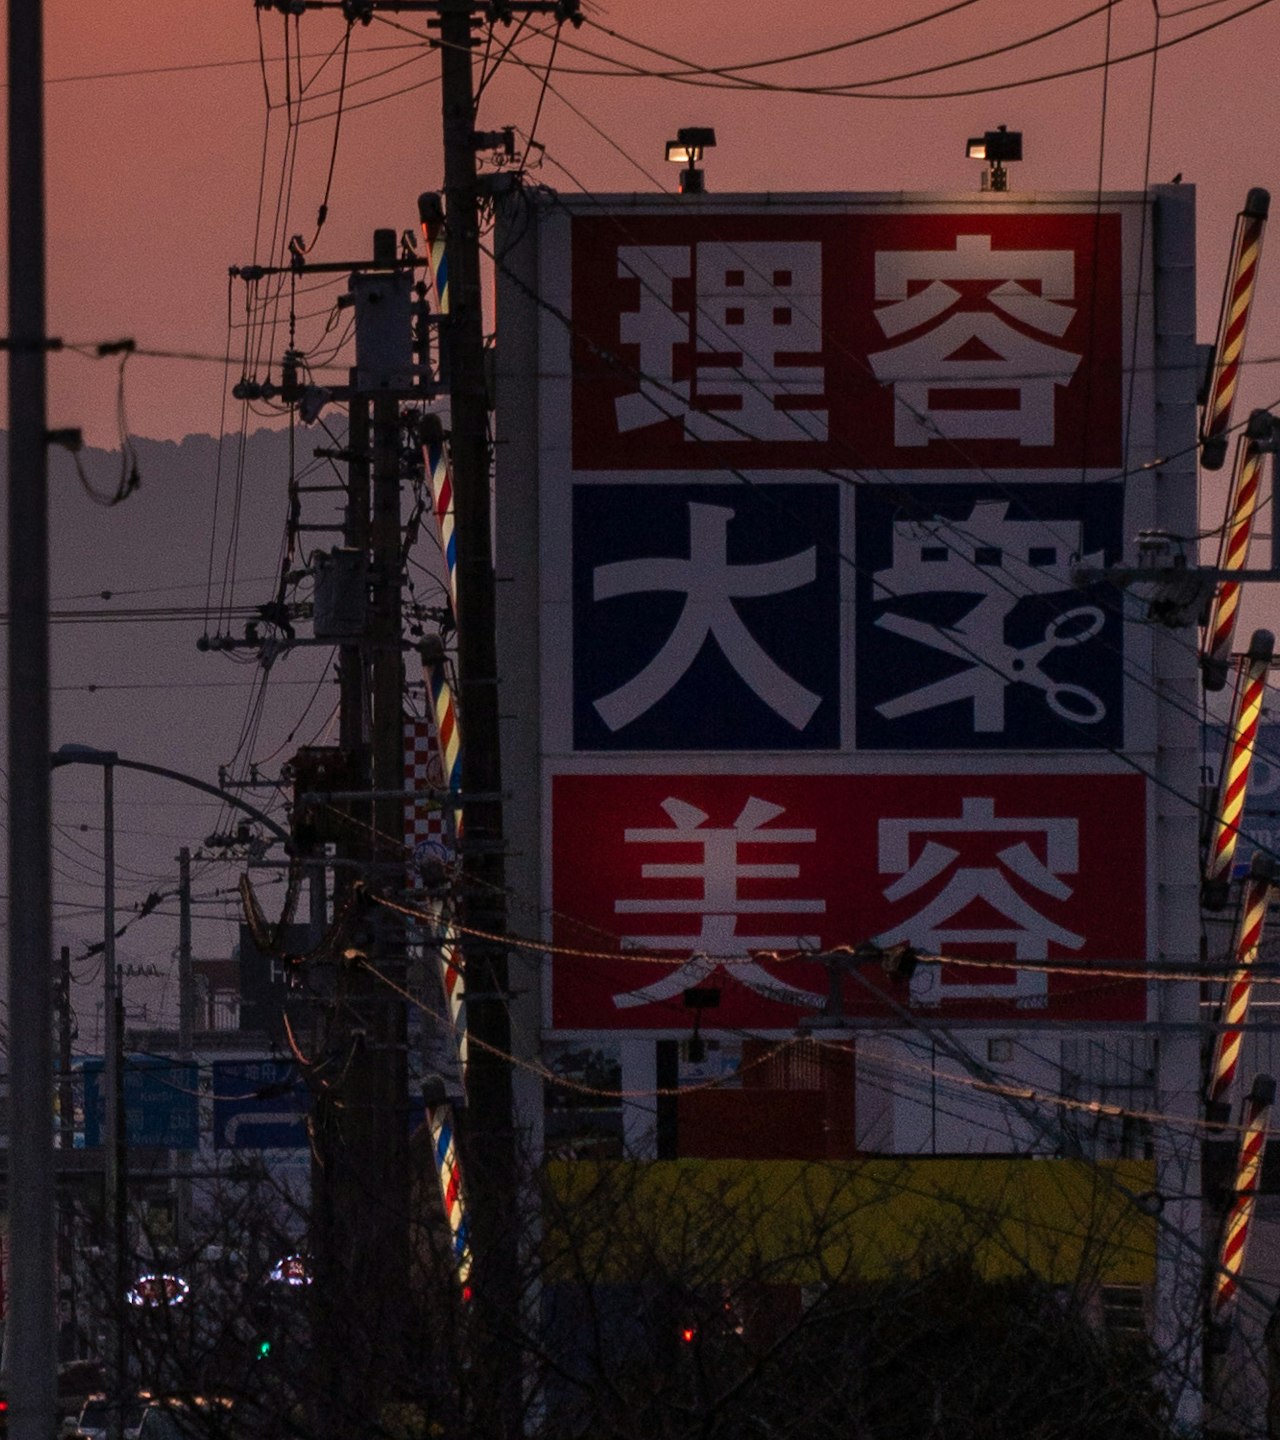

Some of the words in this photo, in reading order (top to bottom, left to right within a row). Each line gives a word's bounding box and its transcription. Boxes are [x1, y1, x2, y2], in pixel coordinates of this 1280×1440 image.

[615, 234, 1083, 447] 理容
[592, 499, 1106, 733] 大衆
[612, 795, 1088, 1011] 美容
